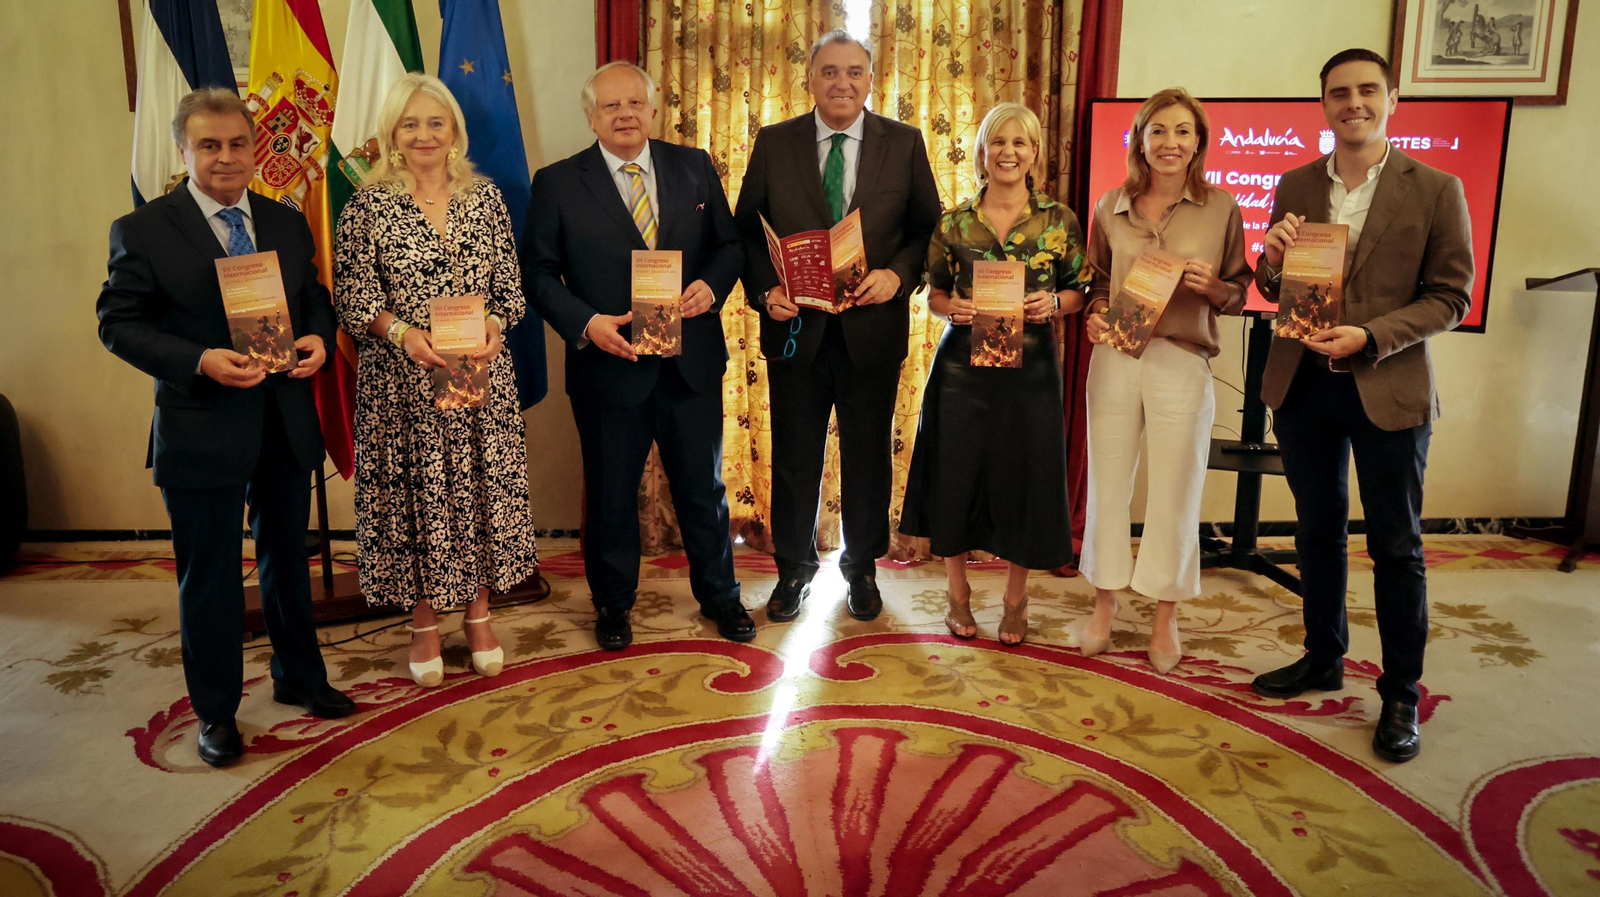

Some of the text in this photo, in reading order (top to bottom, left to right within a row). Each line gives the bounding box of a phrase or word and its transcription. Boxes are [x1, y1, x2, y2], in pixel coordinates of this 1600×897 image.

[1219, 127, 1305, 148] Andalucía
[1385, 136, 1431, 150] CTES
[1140, 255, 1173, 273] Internacional
[1150, 254, 1172, 267] Congreso
[224, 267, 268, 279] Internacional
[232, 263, 263, 272] Congreso
